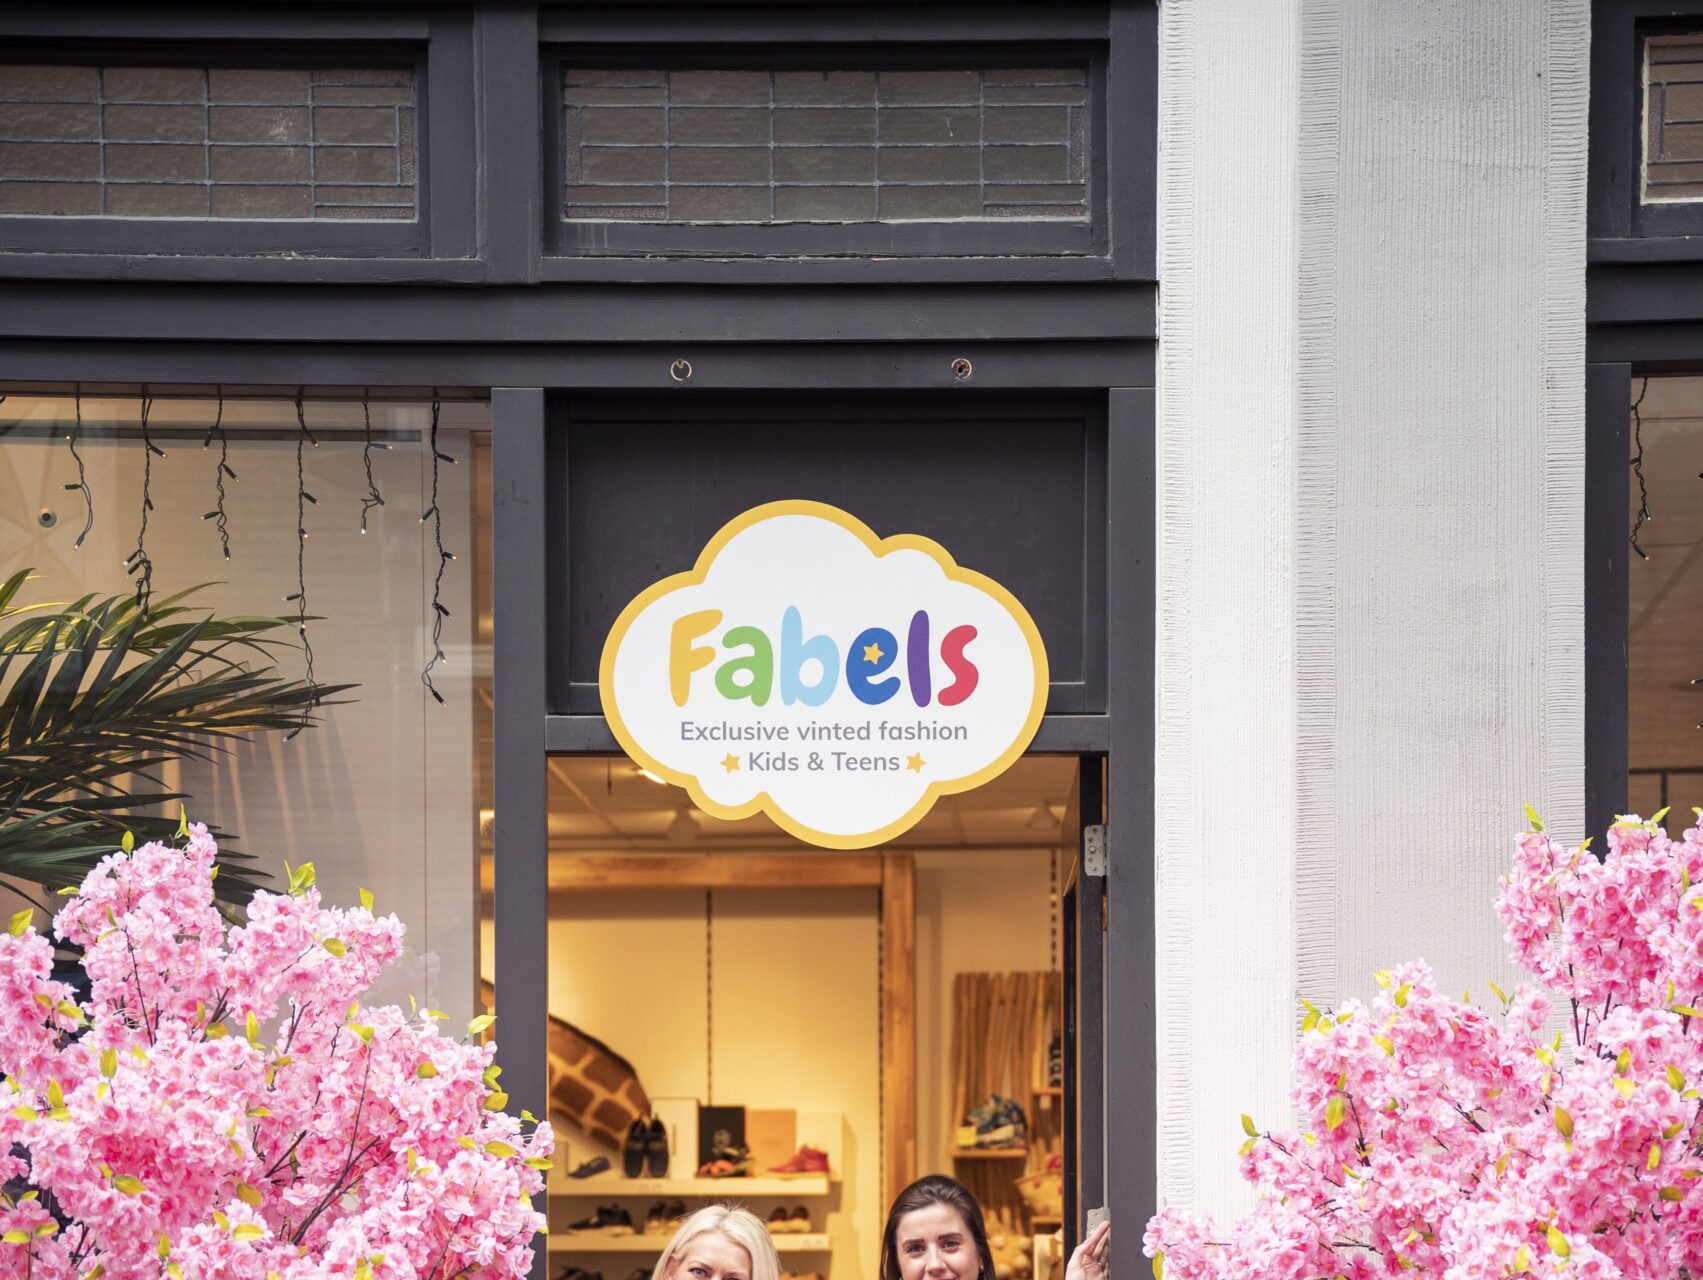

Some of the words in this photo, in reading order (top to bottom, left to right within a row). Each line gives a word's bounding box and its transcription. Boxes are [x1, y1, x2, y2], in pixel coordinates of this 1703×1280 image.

[669, 605, 979, 708] Fabels
[680, 720, 790, 741] Exclusive
[796, 720, 871, 741] vinted
[878, 720, 968, 741] fashion
[748, 751, 799, 772] Kids
[807, 752, 824, 772] &
[831, 751, 900, 772] Teens
